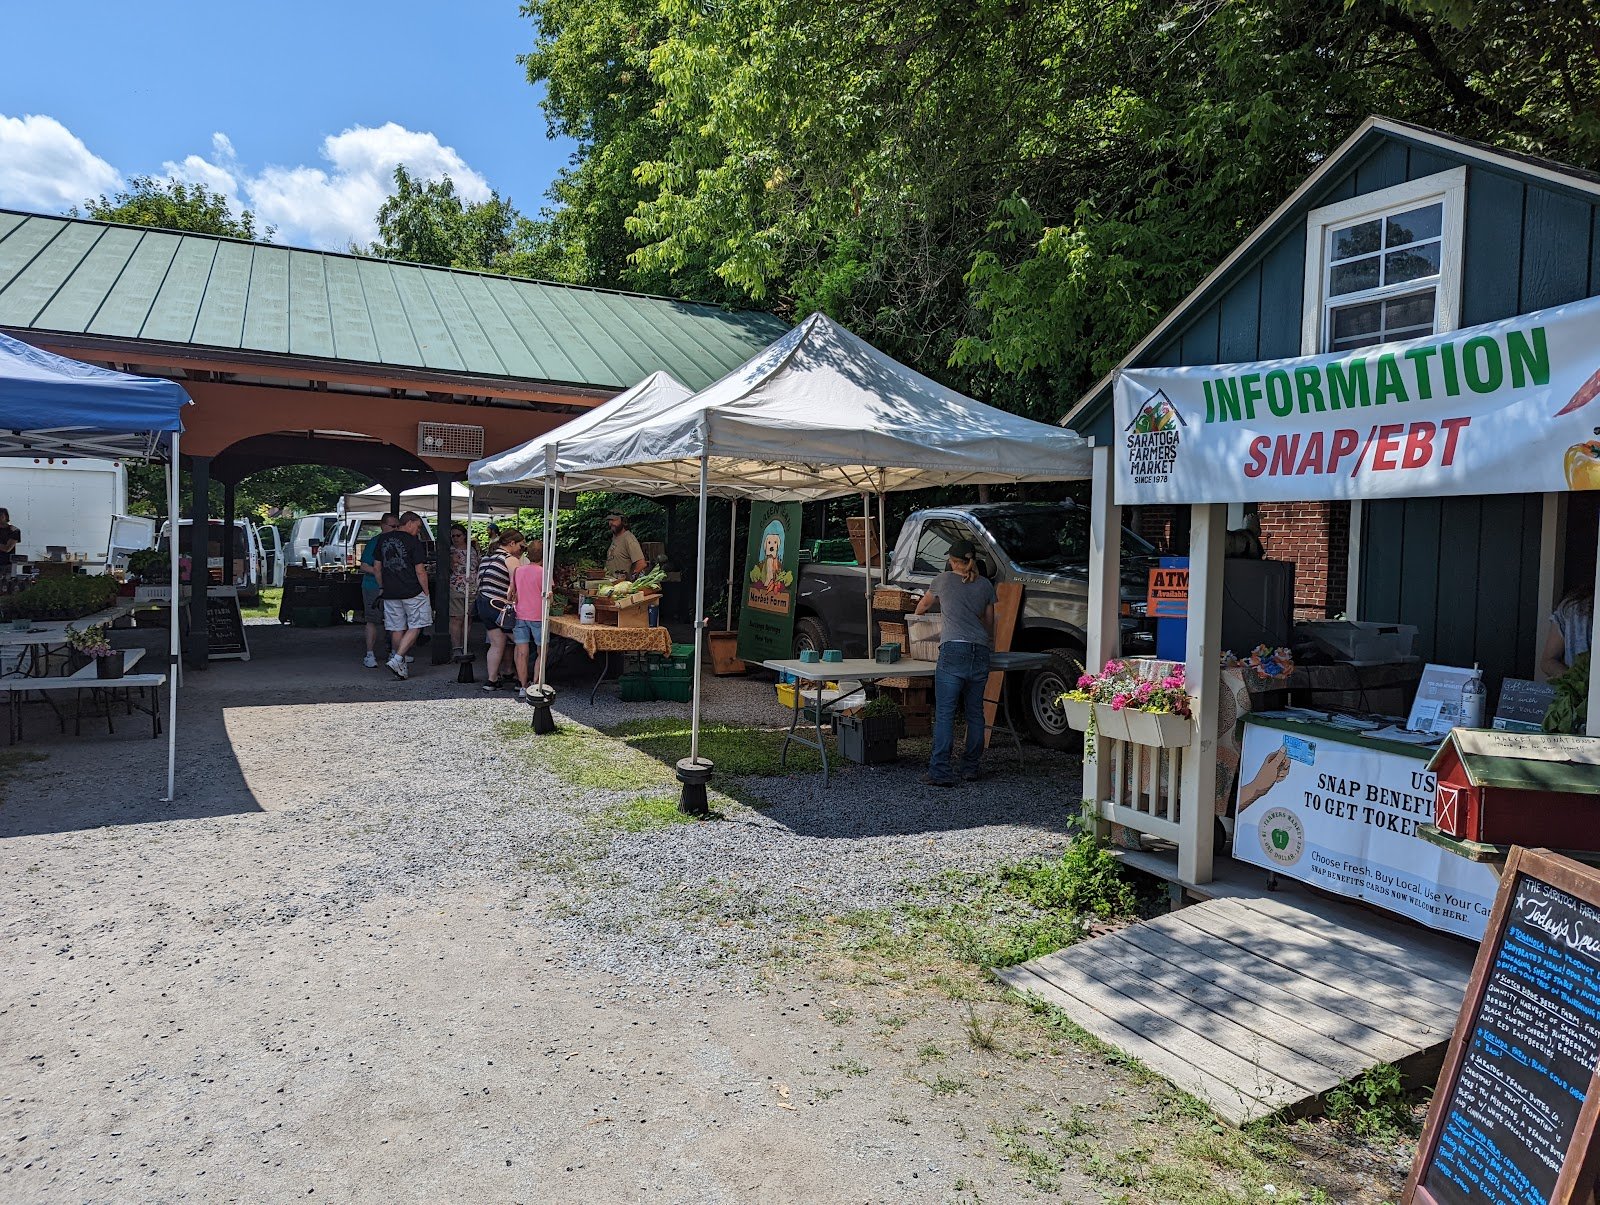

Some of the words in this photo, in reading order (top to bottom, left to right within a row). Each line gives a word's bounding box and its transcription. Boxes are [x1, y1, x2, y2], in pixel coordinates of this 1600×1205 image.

[1203, 327, 1550, 423] INFORMATION
[1127, 431, 1180, 448] SARATOGA
[1129, 445, 1177, 461] FARMERS
[1244, 416, 1471, 478] SNAP/EBT
[1131, 460, 1175, 475] MARKET
[1134, 476, 1152, 484] SINCE
[1153, 475, 1168, 483] 1978
[1154, 571, 1189, 588] ATM
[770, 595, 787, 608] Farm
[1157, 590, 1188, 598] Available
[1317, 773, 1361, 798] SNAP
[1365, 784, 1435, 818] BENEFI
[1411, 771, 1436, 793] US
[1304, 791, 1321, 811] TO
[1324, 797, 1358, 821] GET
[1311, 850, 1340, 869] Choose
[1343, 861, 1373, 878] Fresh.
[1375, 870, 1394, 887] Buy
[1396, 876, 1422, 895] Local.
[1424, 887, 1441, 903] Use
[1444, 893, 1472, 910] Your
[1311, 864, 1327, 876] SNAP
[1328, 870, 1365, 887] BENEFITS
[1366, 881, 1390, 896] CARDS
[1391, 888, 1408, 902] NOW
[1408, 895, 1440, 915] WELCOME
[1442, 908, 1470, 923] HERE.
[1525, 879, 1541, 893] THE
[1542, 886, 1577, 912] SARATOGA
[1524, 898, 1570, 940] Today's
[1496, 960, 1518, 974] DENSE
[1532, 966, 1553, 980] SHELF
[1553, 975, 1574, 991] STABLE
[1564, 953, 1595, 976] PRODUCT
[1583, 976, 1600, 993] PROO
[1488, 983, 1518, 1003] QUANTITY
[1519, 999, 1547, 1019] HARVEST
[1549, 1017, 1558, 1025] OF
[1560, 1023, 1597, 1050] SASKATOON
[1540, 997, 1559, 1012] BERRY
[1480, 1014, 1494, 1023] AND
[1496, 1020, 1510, 1031] RED
[1483, 1004, 1502, 1017] BLACK
[1504, 1013, 1526, 1028] SWEET
[1557, 1042, 1572, 1056] RED
[1486, 994, 1512, 1010] BERRIES
[1551, 1029, 1588, 1057] BLUEBERRY
[1531, 1060, 1548, 1075] BLACK
[1549, 1072, 1568, 1090] SOUR
[1506, 1075, 1528, 1095] PEANUT
[1529, 1092, 1550, 1114] BUTTER
[1520, 1120, 1526, 1128] A
[1527, 1126, 1550, 1148] PEANUT
[1521, 1104, 1554, 1133] PROMOTION
[1555, 1133, 1562, 1143] IS
[1533, 1146, 1562, 1174] CRANBERR
